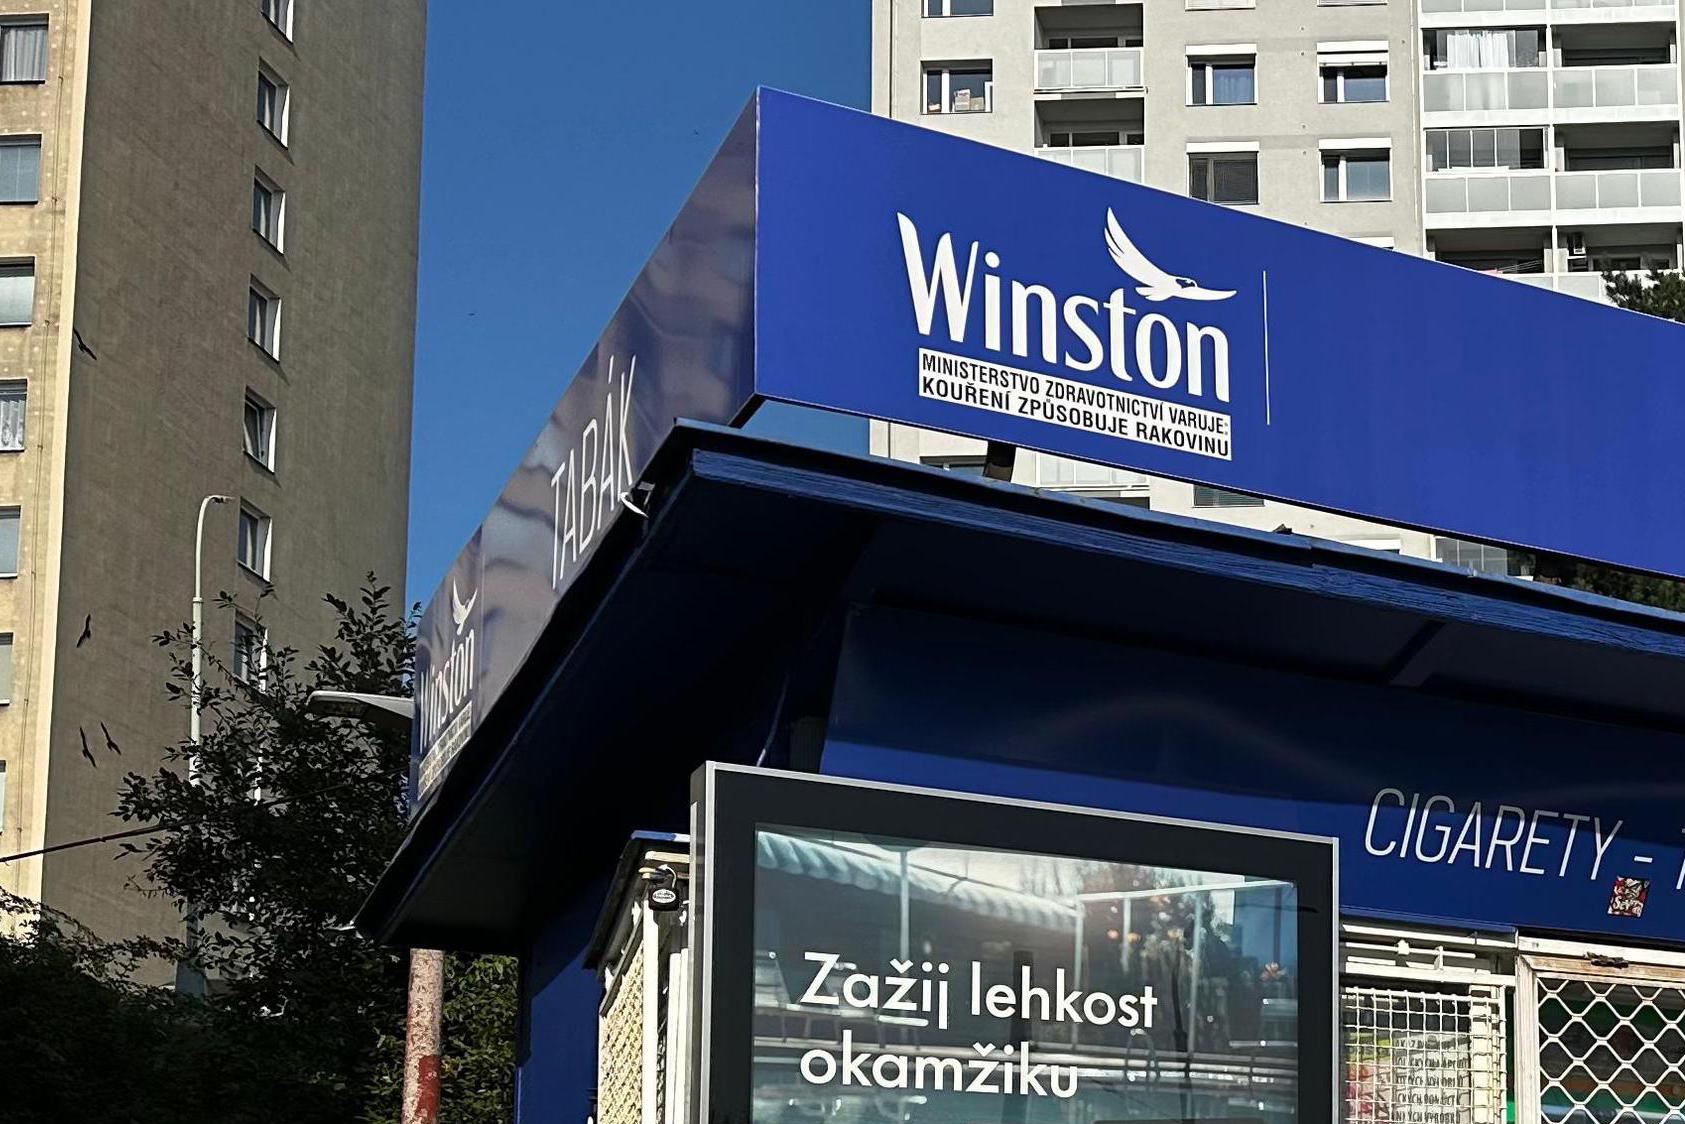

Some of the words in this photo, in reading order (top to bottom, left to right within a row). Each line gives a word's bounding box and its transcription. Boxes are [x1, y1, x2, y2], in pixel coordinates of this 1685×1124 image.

[897, 211, 1230, 402] Winston
[922, 354, 1040, 394] MINISTERSTVO
[1045, 379, 1165, 421] ZDRAVOTNICTVÍ
[1169, 406, 1229, 436] VARUJE:
[922, 376, 1011, 412] KOUŘENÍ
[1018, 396, 1129, 436] ZPŮSOBUJE
[1136, 423, 1229, 457] RAKOVINU
[551, 355, 636, 589] TABÁK
[420, 629, 475, 755] Winston
[1364, 788, 1623, 881] CIGARETY
[800, 952, 949, 1030] Zažij
[971, 961, 1158, 1028] lehkost
[800, 1029, 1079, 1098] okamžiku
